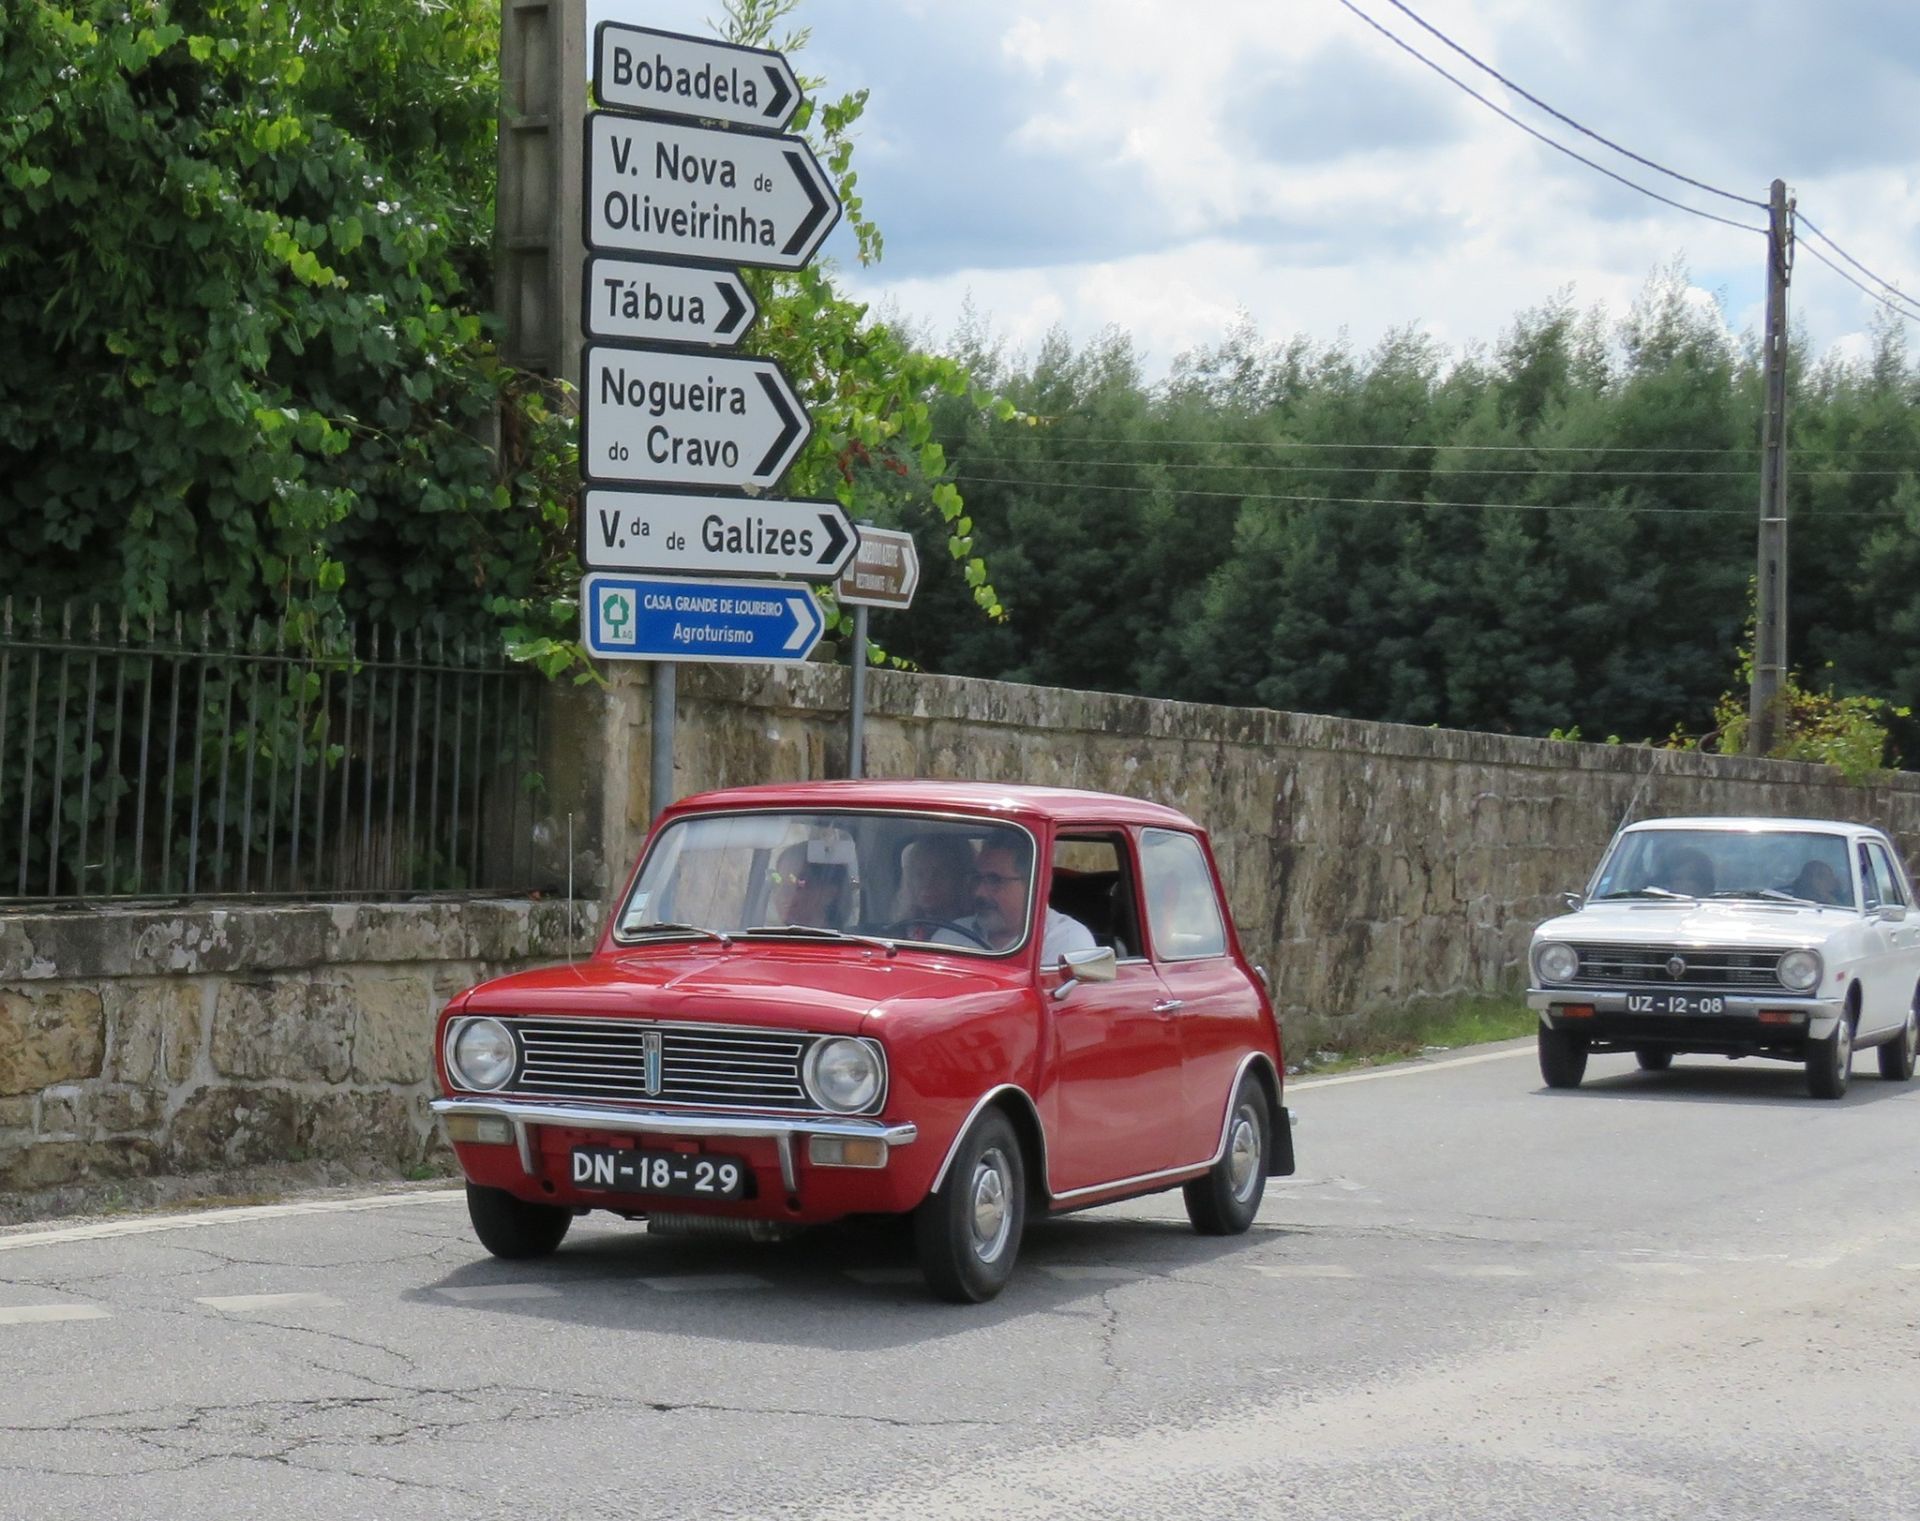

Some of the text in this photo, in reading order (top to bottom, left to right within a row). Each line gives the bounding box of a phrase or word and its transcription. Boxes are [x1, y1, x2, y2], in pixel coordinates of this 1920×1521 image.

[613, 46, 758, 108] Bobadela
[611, 135, 773, 193] V. Nova de
[604, 190, 776, 247] Oliveirinha
[604, 278, 706, 325] Tábua
[601, 366, 747, 417] Nogueira
[608, 425, 739, 468] do Cravo
[666, 531, 686, 551] de
[702, 514, 814, 557] Galizes
[644, 594, 783, 617] CASA GRANDE DE LOUREIRO
[673, 622, 754, 644] Agroturismo
[1627, 995, 1723, 1014] UZ-12-08
[573, 1152, 739, 1193] DN-18-29
